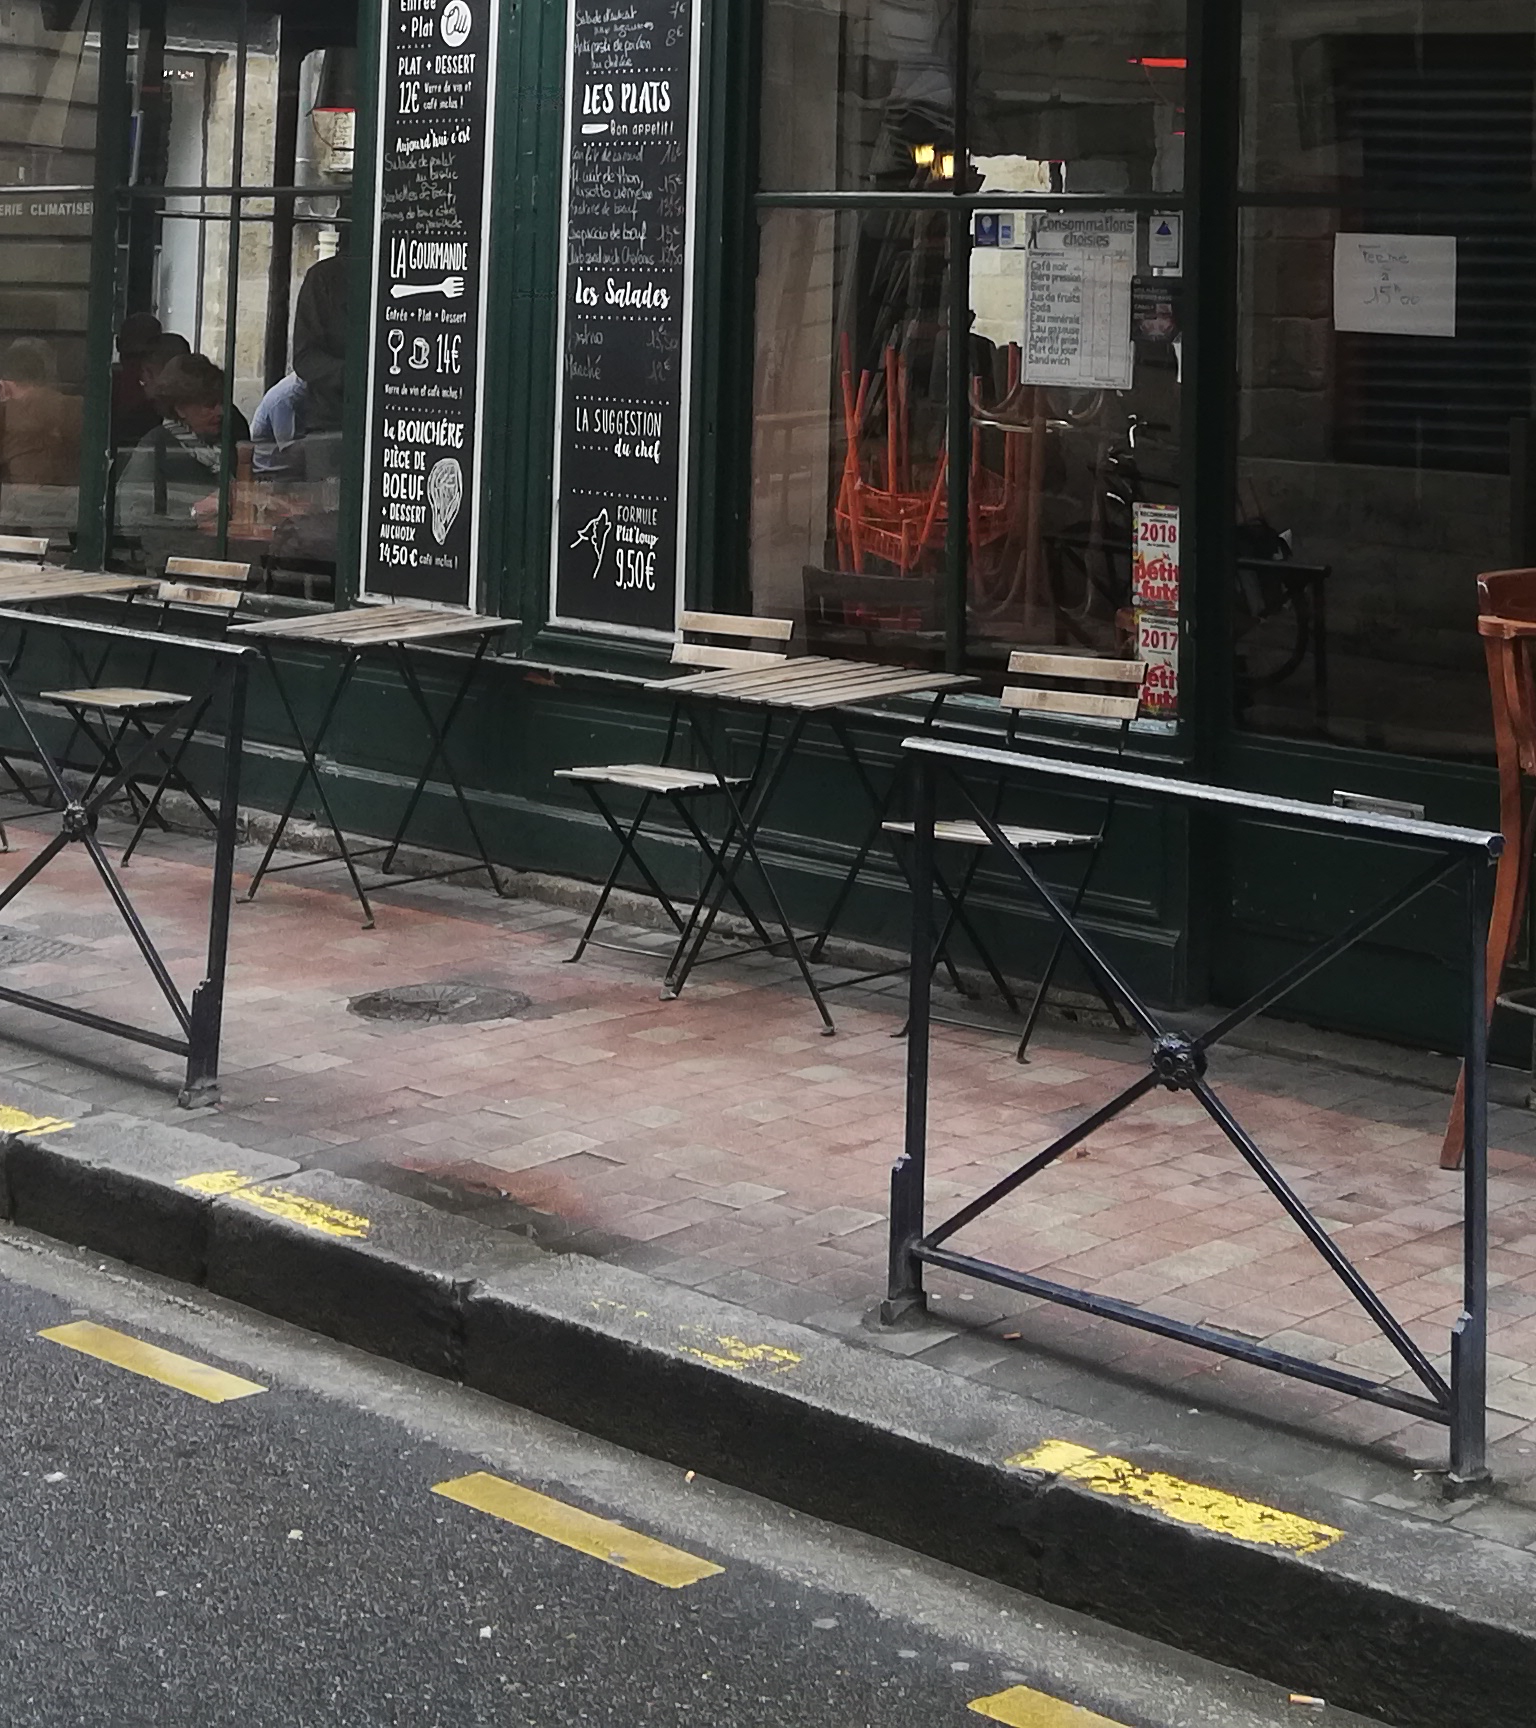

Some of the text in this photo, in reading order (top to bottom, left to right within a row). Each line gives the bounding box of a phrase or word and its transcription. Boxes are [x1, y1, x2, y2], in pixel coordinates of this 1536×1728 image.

[411, 15, 434, 38] Plat
[398, 53, 476, 76] PLAT DESSERT
[398, 80, 420, 114] 12€
[582, 81, 671, 115] LES PLATS
[610, 119, 628, 136] Bon
[396, 125, 471, 156] Aujourd'hui c'est
[1037, 215, 1135, 233] Consommations
[1063, 232, 1110, 248] choisies
[390, 237, 468, 278] LA GOURMANDE
[1030, 260, 1068, 272] Café noir
[1051, 272, 1081, 284] pression
[604, 277, 671, 309] Salades
[1030, 291, 1081, 303] Jus de fruits
[386, 306, 467, 323] Entrée Plat Dessert
[1030, 302, 1051, 313] Soda
[1030, 312, 1045, 323] Eau
[1030, 323, 1046, 333] Eau
[436, 333, 462, 374] 14€
[1028, 354, 1070, 366] Sandwich
[1029, 344, 1077, 357] Plat du jour
[576, 406, 662, 437] LA SUGGESTION
[383, 444, 426, 471] PIÈCE DE
[614, 437, 661, 464] du chef
[382, 471, 425, 501] BOEUF
[389, 502, 427, 524] DESSERT
[617, 505, 658, 526] FORMULE
[1140, 522, 1177, 543] 2018
[615, 548, 656, 591] 9,50€
[1141, 629, 1178, 651] 2017
